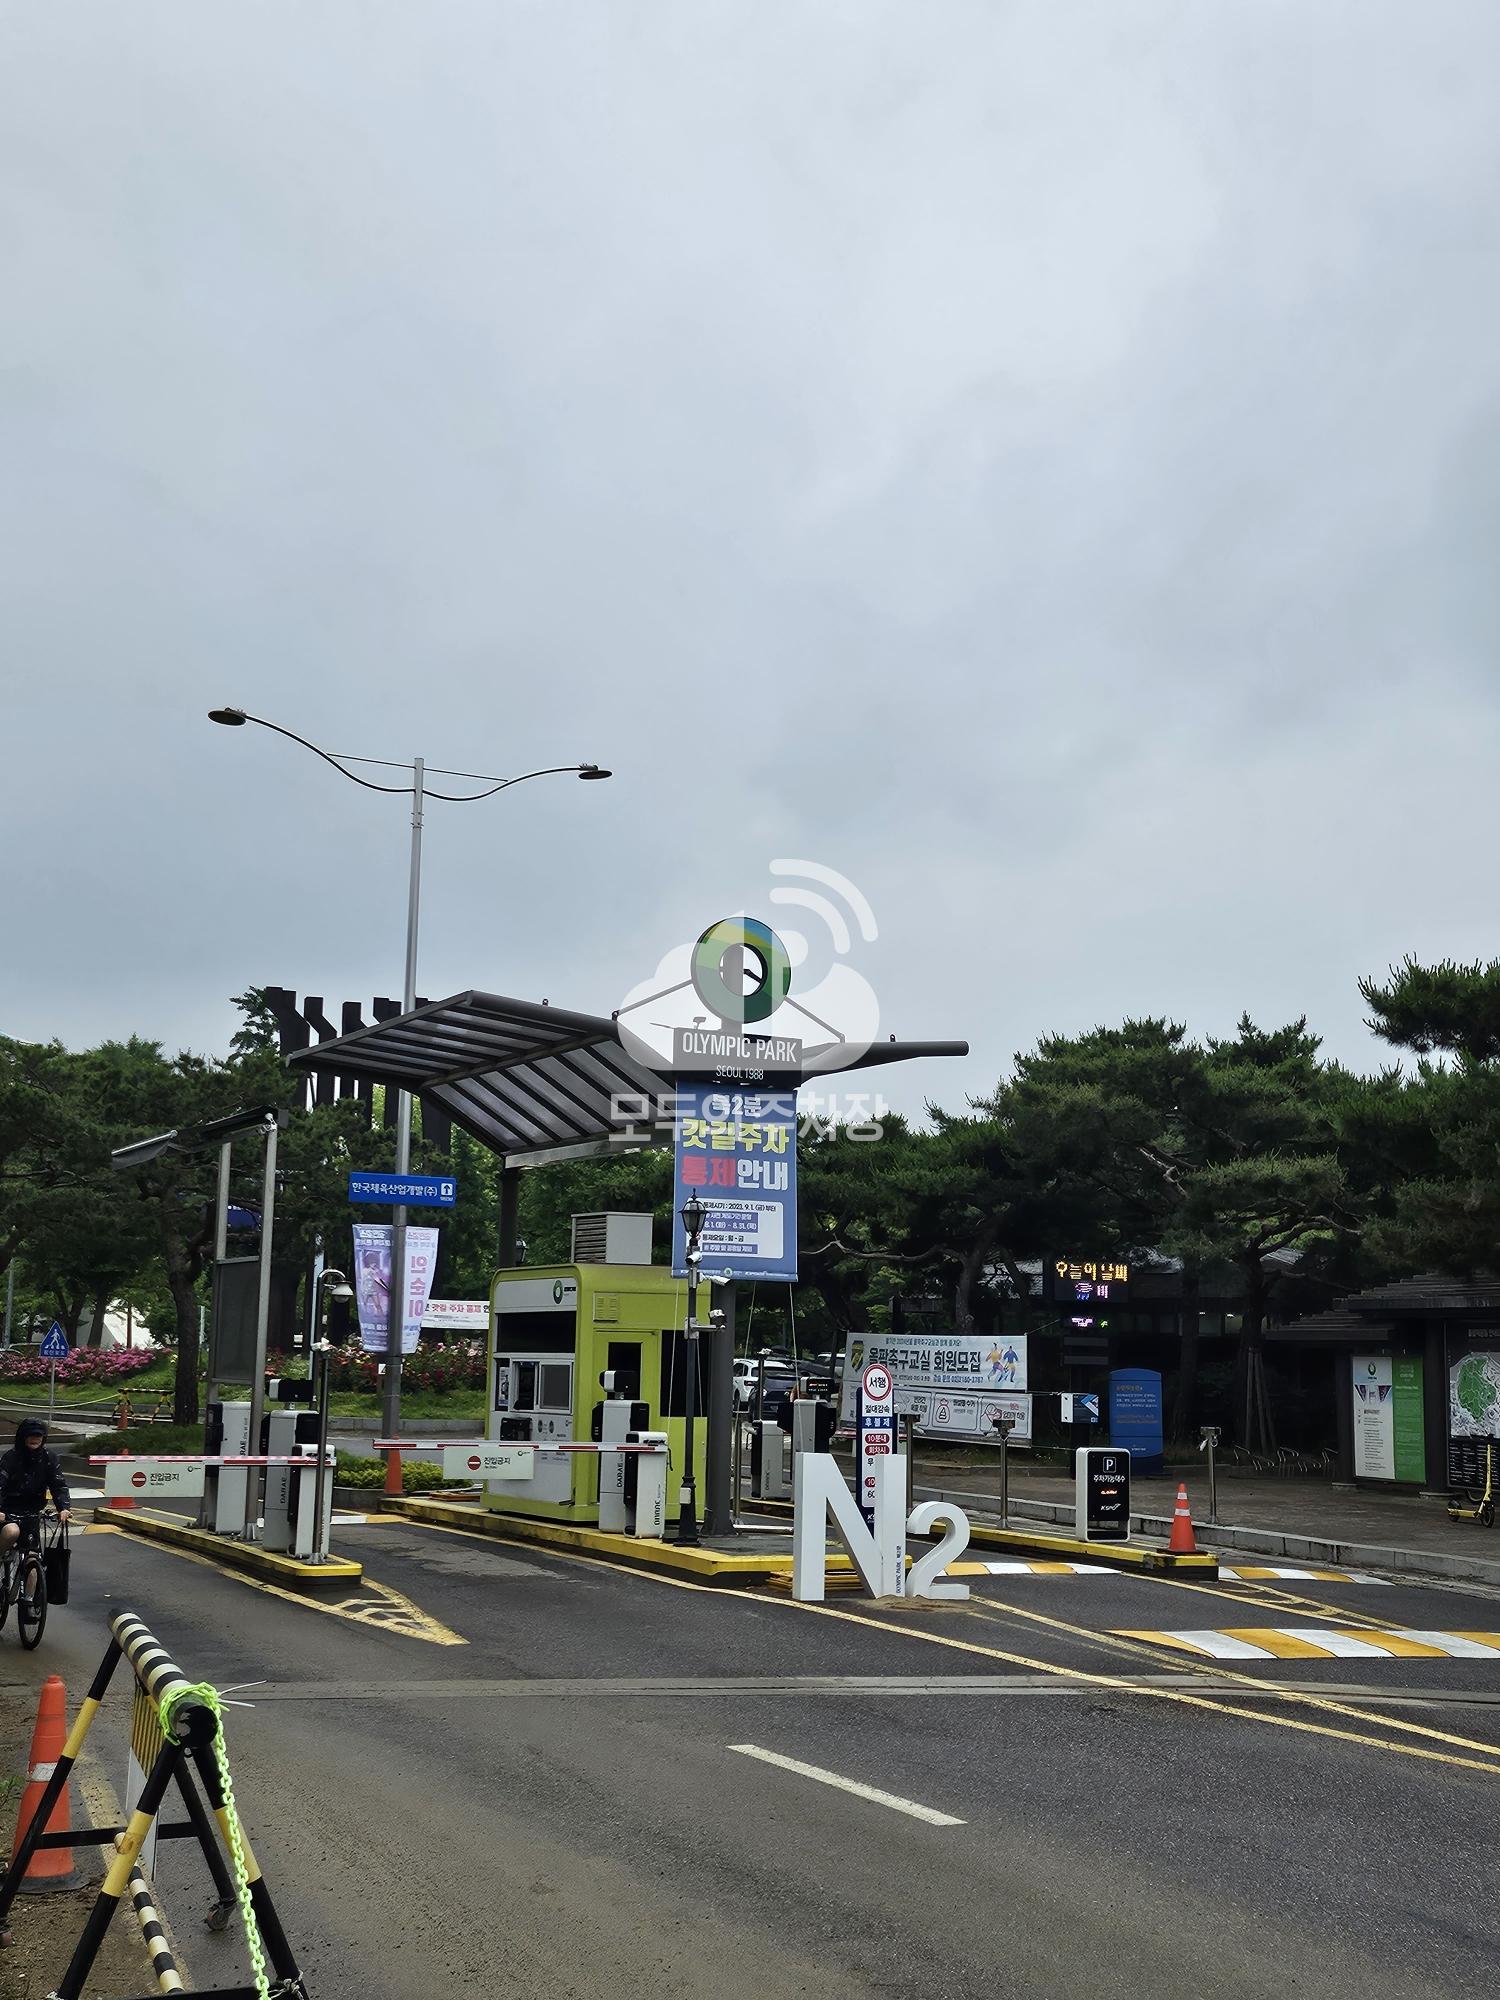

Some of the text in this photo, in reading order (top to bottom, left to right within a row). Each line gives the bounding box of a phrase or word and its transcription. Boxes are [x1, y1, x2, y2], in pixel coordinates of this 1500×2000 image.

[682, 1031, 797, 1063] OLYMPIC PARK
[716, 1064, 764, 1080] SEOUL 1988
[711, 1094, 763, 1117] 북2문
[682, 1117, 790, 1154] 갓길주차
[681, 1155, 789, 1191] 통제안내
[352, 1182, 437, 1197] 한국체육산업개발(주)
[933, 1350, 981, 1374] 회원모집
[869, 1376, 887, 1389] 서행
[865, 1404, 890, 1414] 절대감속
[867, 1434, 887, 1443] 10분내
[483, 1455, 511, 1466] 진입금지
[1106, 1459, 1114, 1471] P
[150, 1472, 180, 1483] 진입금지
[616, 1461, 624, 1488] DARAE
